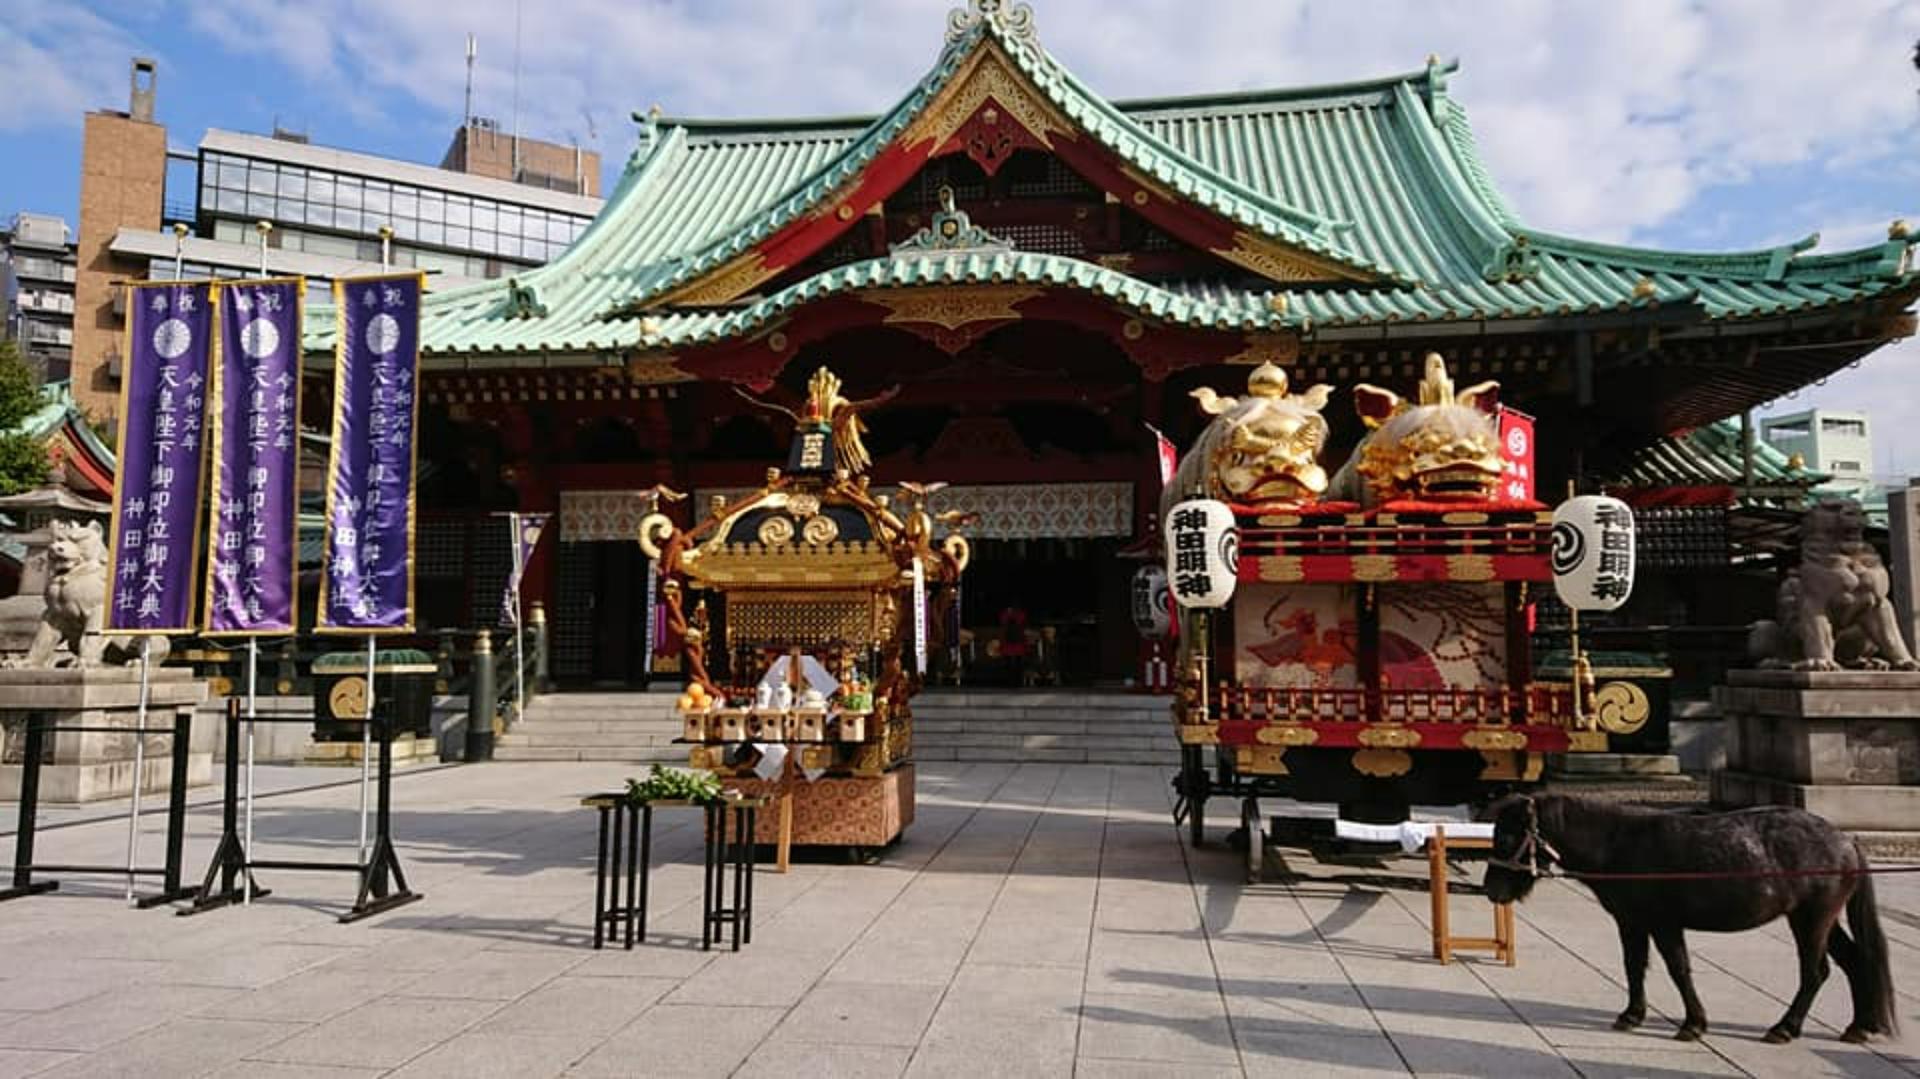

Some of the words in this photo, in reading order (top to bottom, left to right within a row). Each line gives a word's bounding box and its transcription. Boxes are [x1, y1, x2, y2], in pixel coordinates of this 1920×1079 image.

[151, 293, 197, 313] 奉祝
[236, 292, 282, 312] 奉祝
[362, 288, 404, 308] 奉祝
[180, 371, 203, 451] 令和元年
[274, 371, 294, 450] 令和元年
[391, 367, 412, 449] 令和元年
[136, 365, 180, 619] 天皇陛下御即位御大典
[116, 497, 145, 611] 神田神社
[217, 497, 245, 611] 神田神社
[329, 494, 361, 608] 神田神社
[1171, 508, 1213, 598] 神田明神
[1592, 505, 1632, 601] 神田明神
